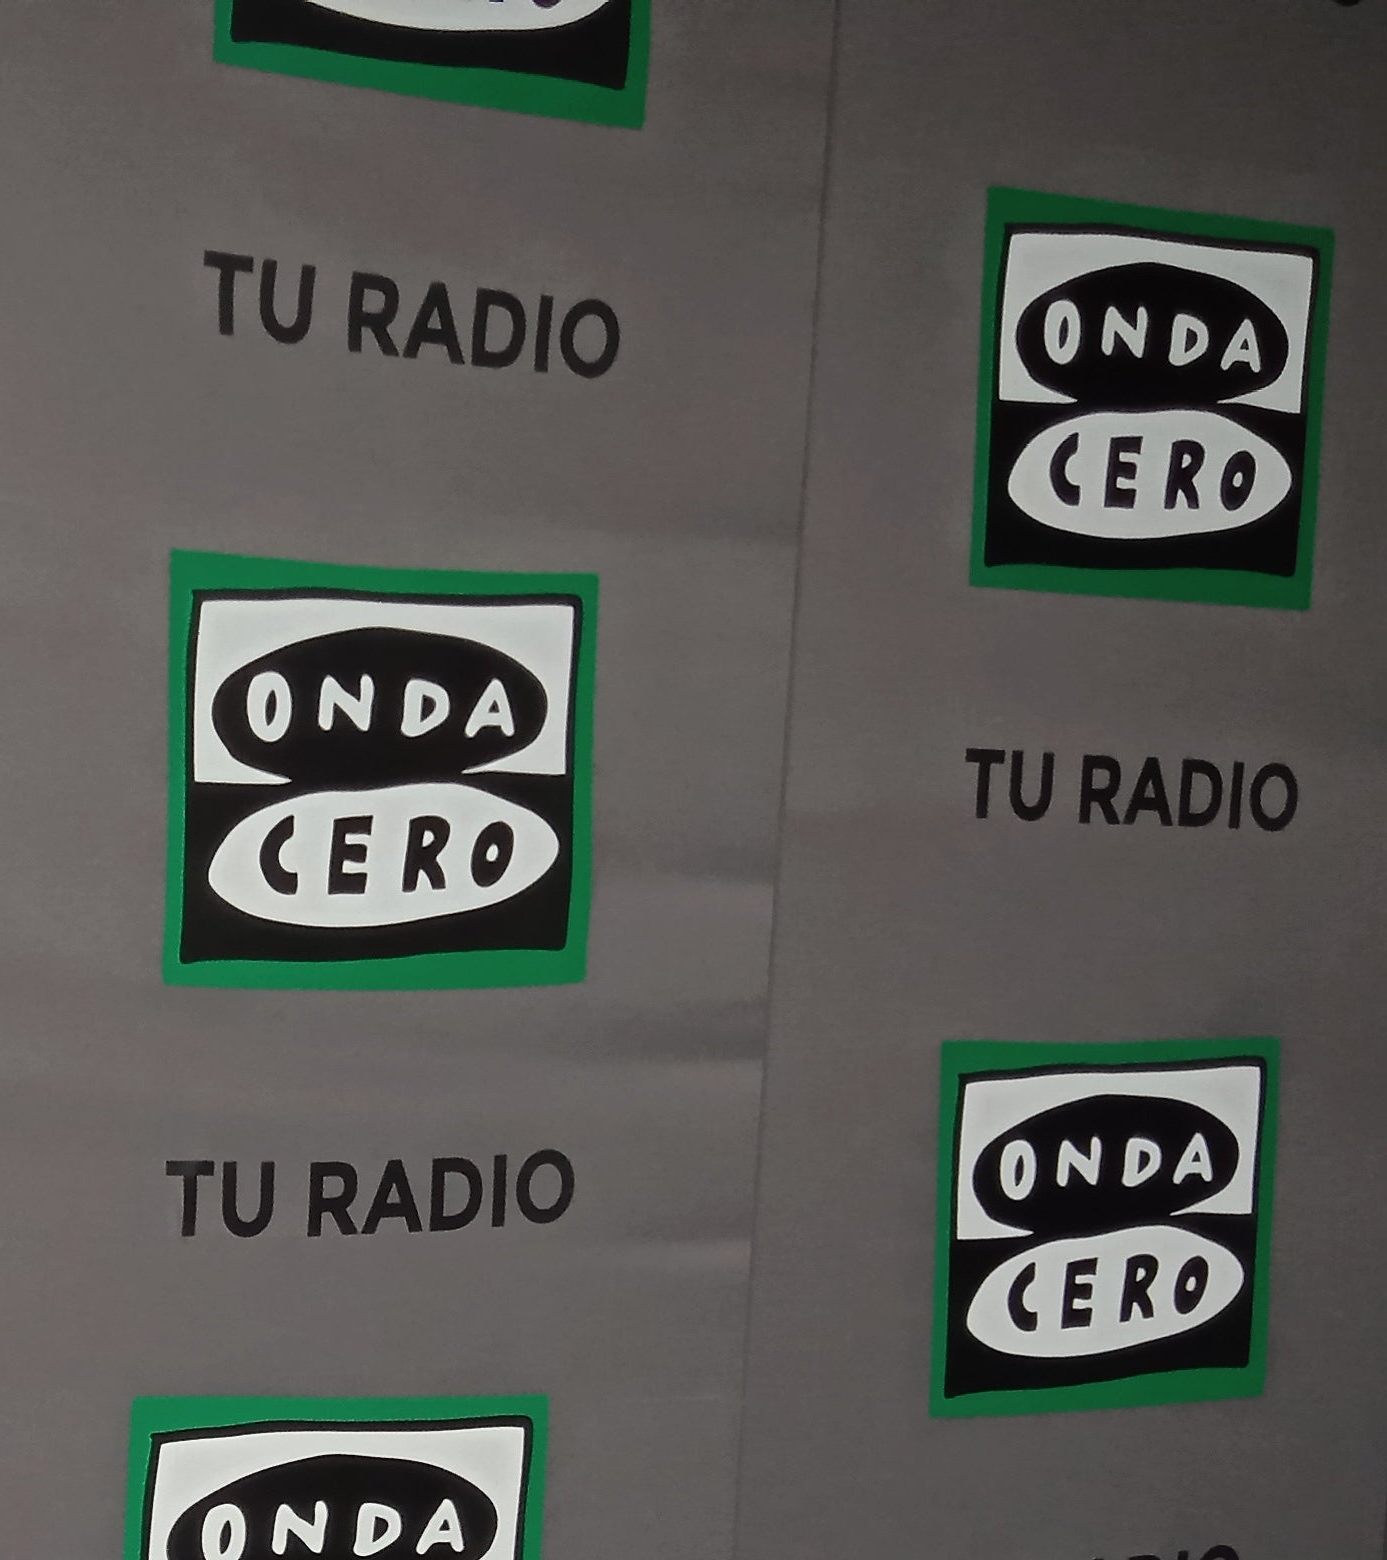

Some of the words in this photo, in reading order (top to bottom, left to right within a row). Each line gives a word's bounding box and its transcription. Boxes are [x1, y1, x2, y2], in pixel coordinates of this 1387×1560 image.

[204, 250, 316, 344] TU
[347, 271, 621, 379] RADIO
[1043, 299, 1261, 373] ONDA
[1049, 432, 1257, 512] CERO
[246, 670, 515, 743] ONDA
[965, 748, 1055, 822] TU
[1079, 754, 1299, 832] RADIO
[259, 814, 515, 896] CERO
[166, 1160, 275, 1238] TU
[307, 1148, 575, 1237] RADIO
[999, 1132, 1213, 1201] ONDA
[1007, 1253, 1209, 1332] CERO
